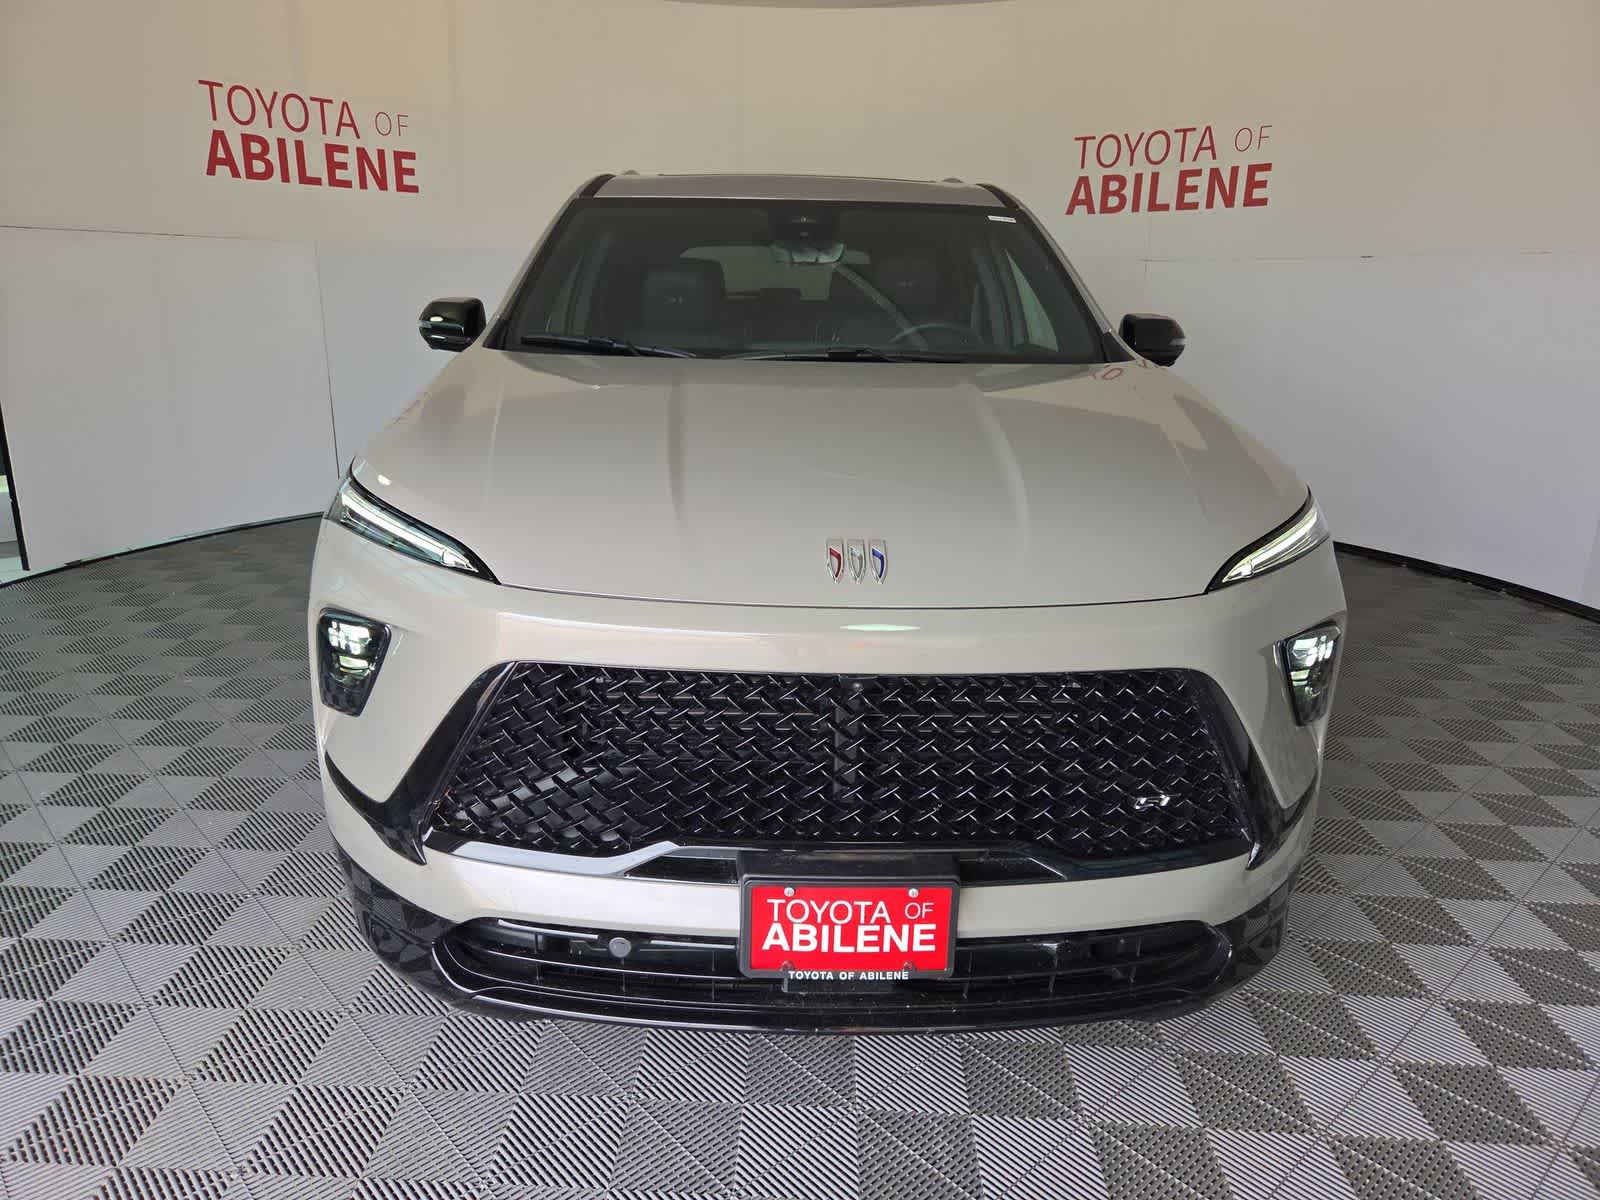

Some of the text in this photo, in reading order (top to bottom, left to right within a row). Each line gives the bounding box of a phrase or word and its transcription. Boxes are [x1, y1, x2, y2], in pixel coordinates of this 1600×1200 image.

[198, 79, 409, 139] TOYOTA OF
[206, 128, 420, 193] ABILENE
[1074, 124, 1273, 169] TOYOTA OF
[1064, 162, 1273, 216] ABILENE
[766, 898, 935, 924] TOYOTA OF
[761, 922, 937, 953] ABILENE
[788, 970, 909, 981] TOYOTA OF ABILENE
